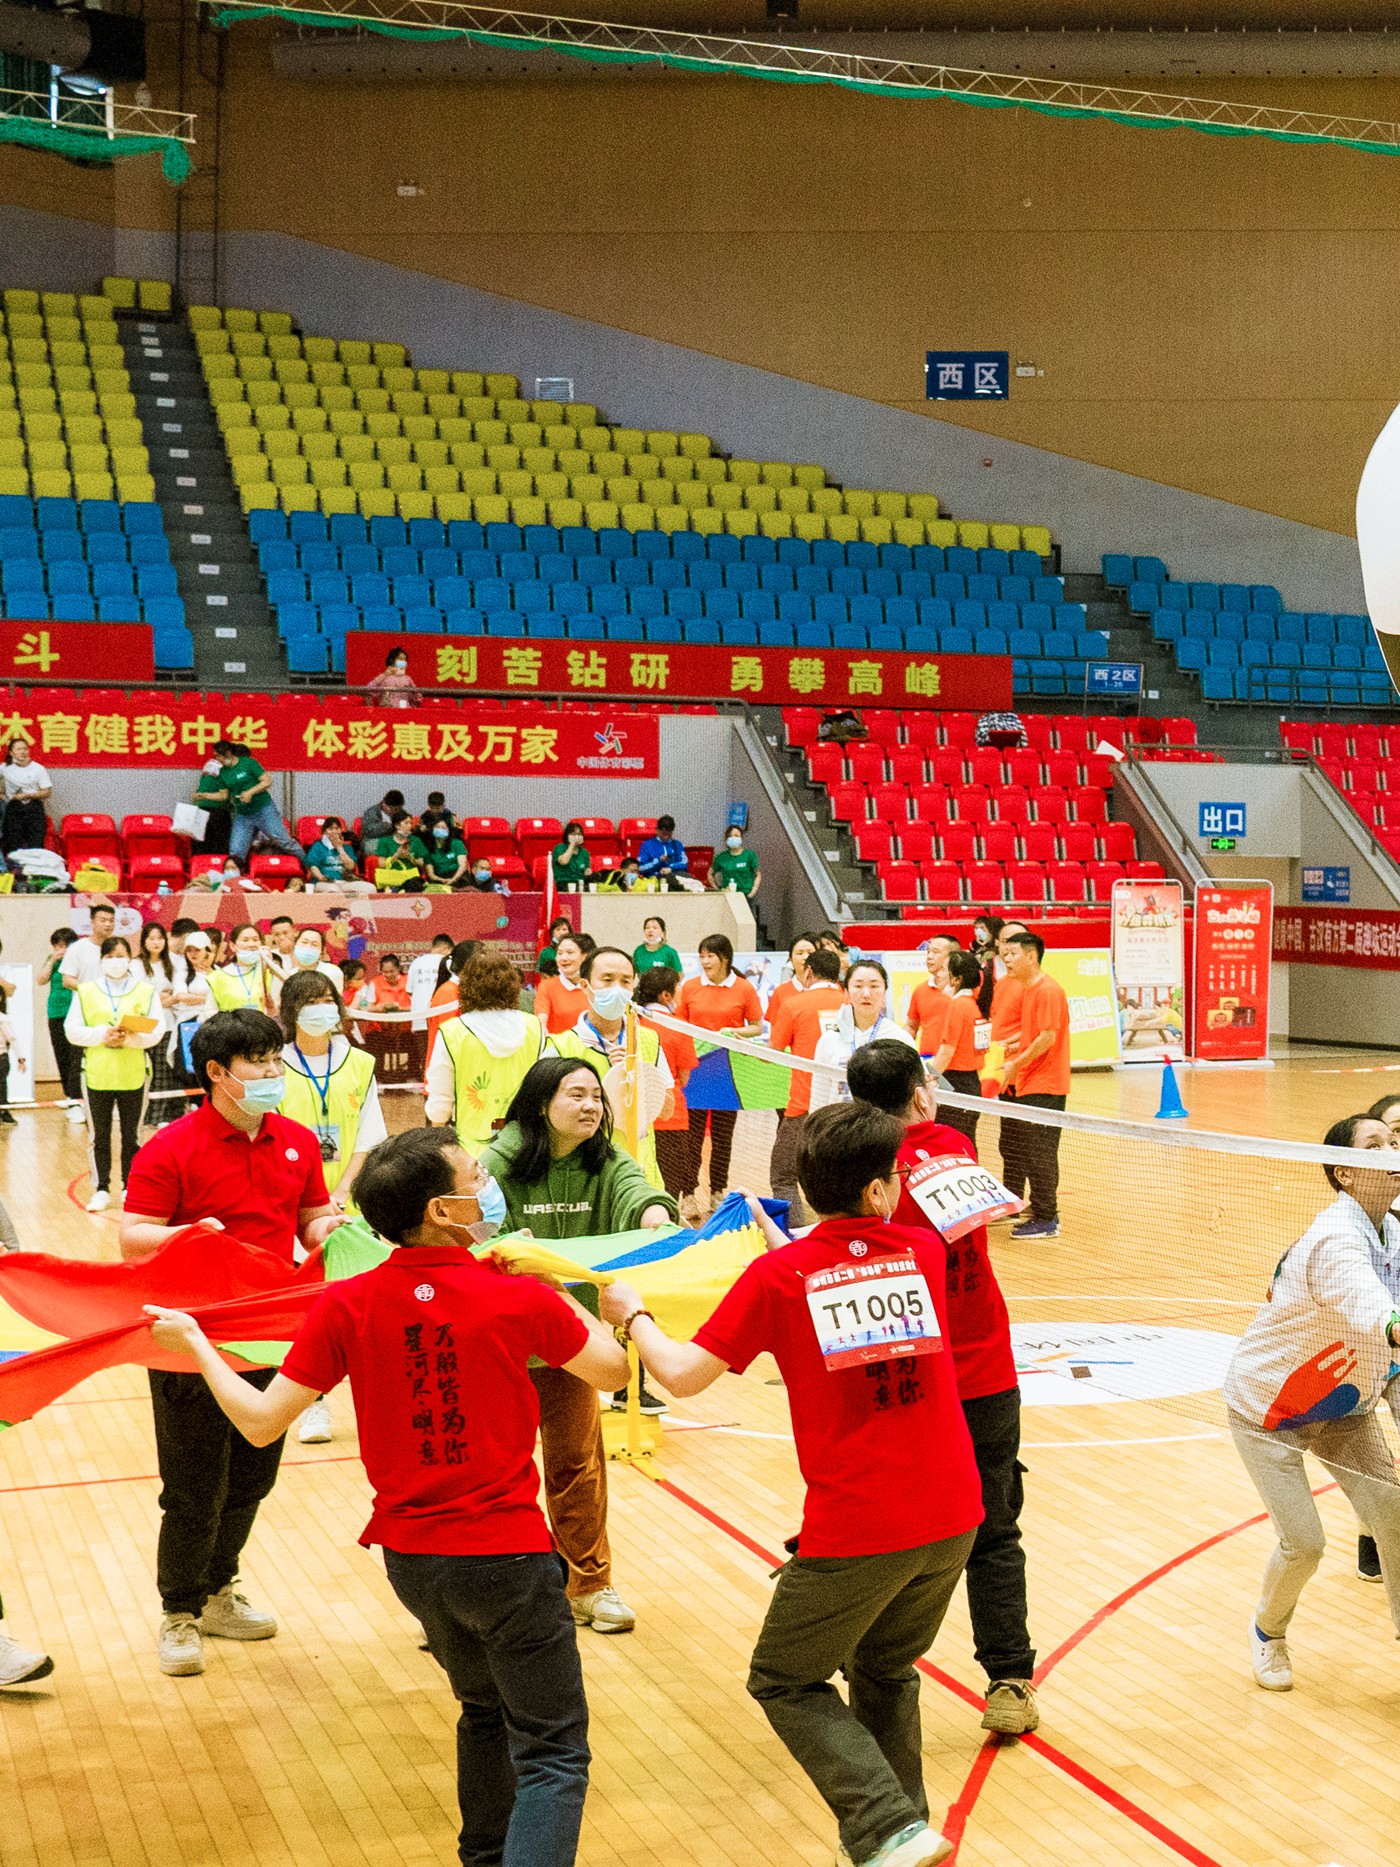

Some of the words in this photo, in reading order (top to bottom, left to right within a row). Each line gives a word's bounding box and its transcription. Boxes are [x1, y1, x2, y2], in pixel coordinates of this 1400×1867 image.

[936, 362, 1000, 389] 西区
[14, 631, 60, 672] 斗
[436, 644, 670, 690] 刻苦钻研
[730, 655, 941, 698] 勇攀高峰
[302, 718, 559, 765] 体彩惠及万家
[1203, 806, 1243, 832] 出口
[925, 1175, 997, 1210] T1003
[822, 1290, 924, 1329] T1005
